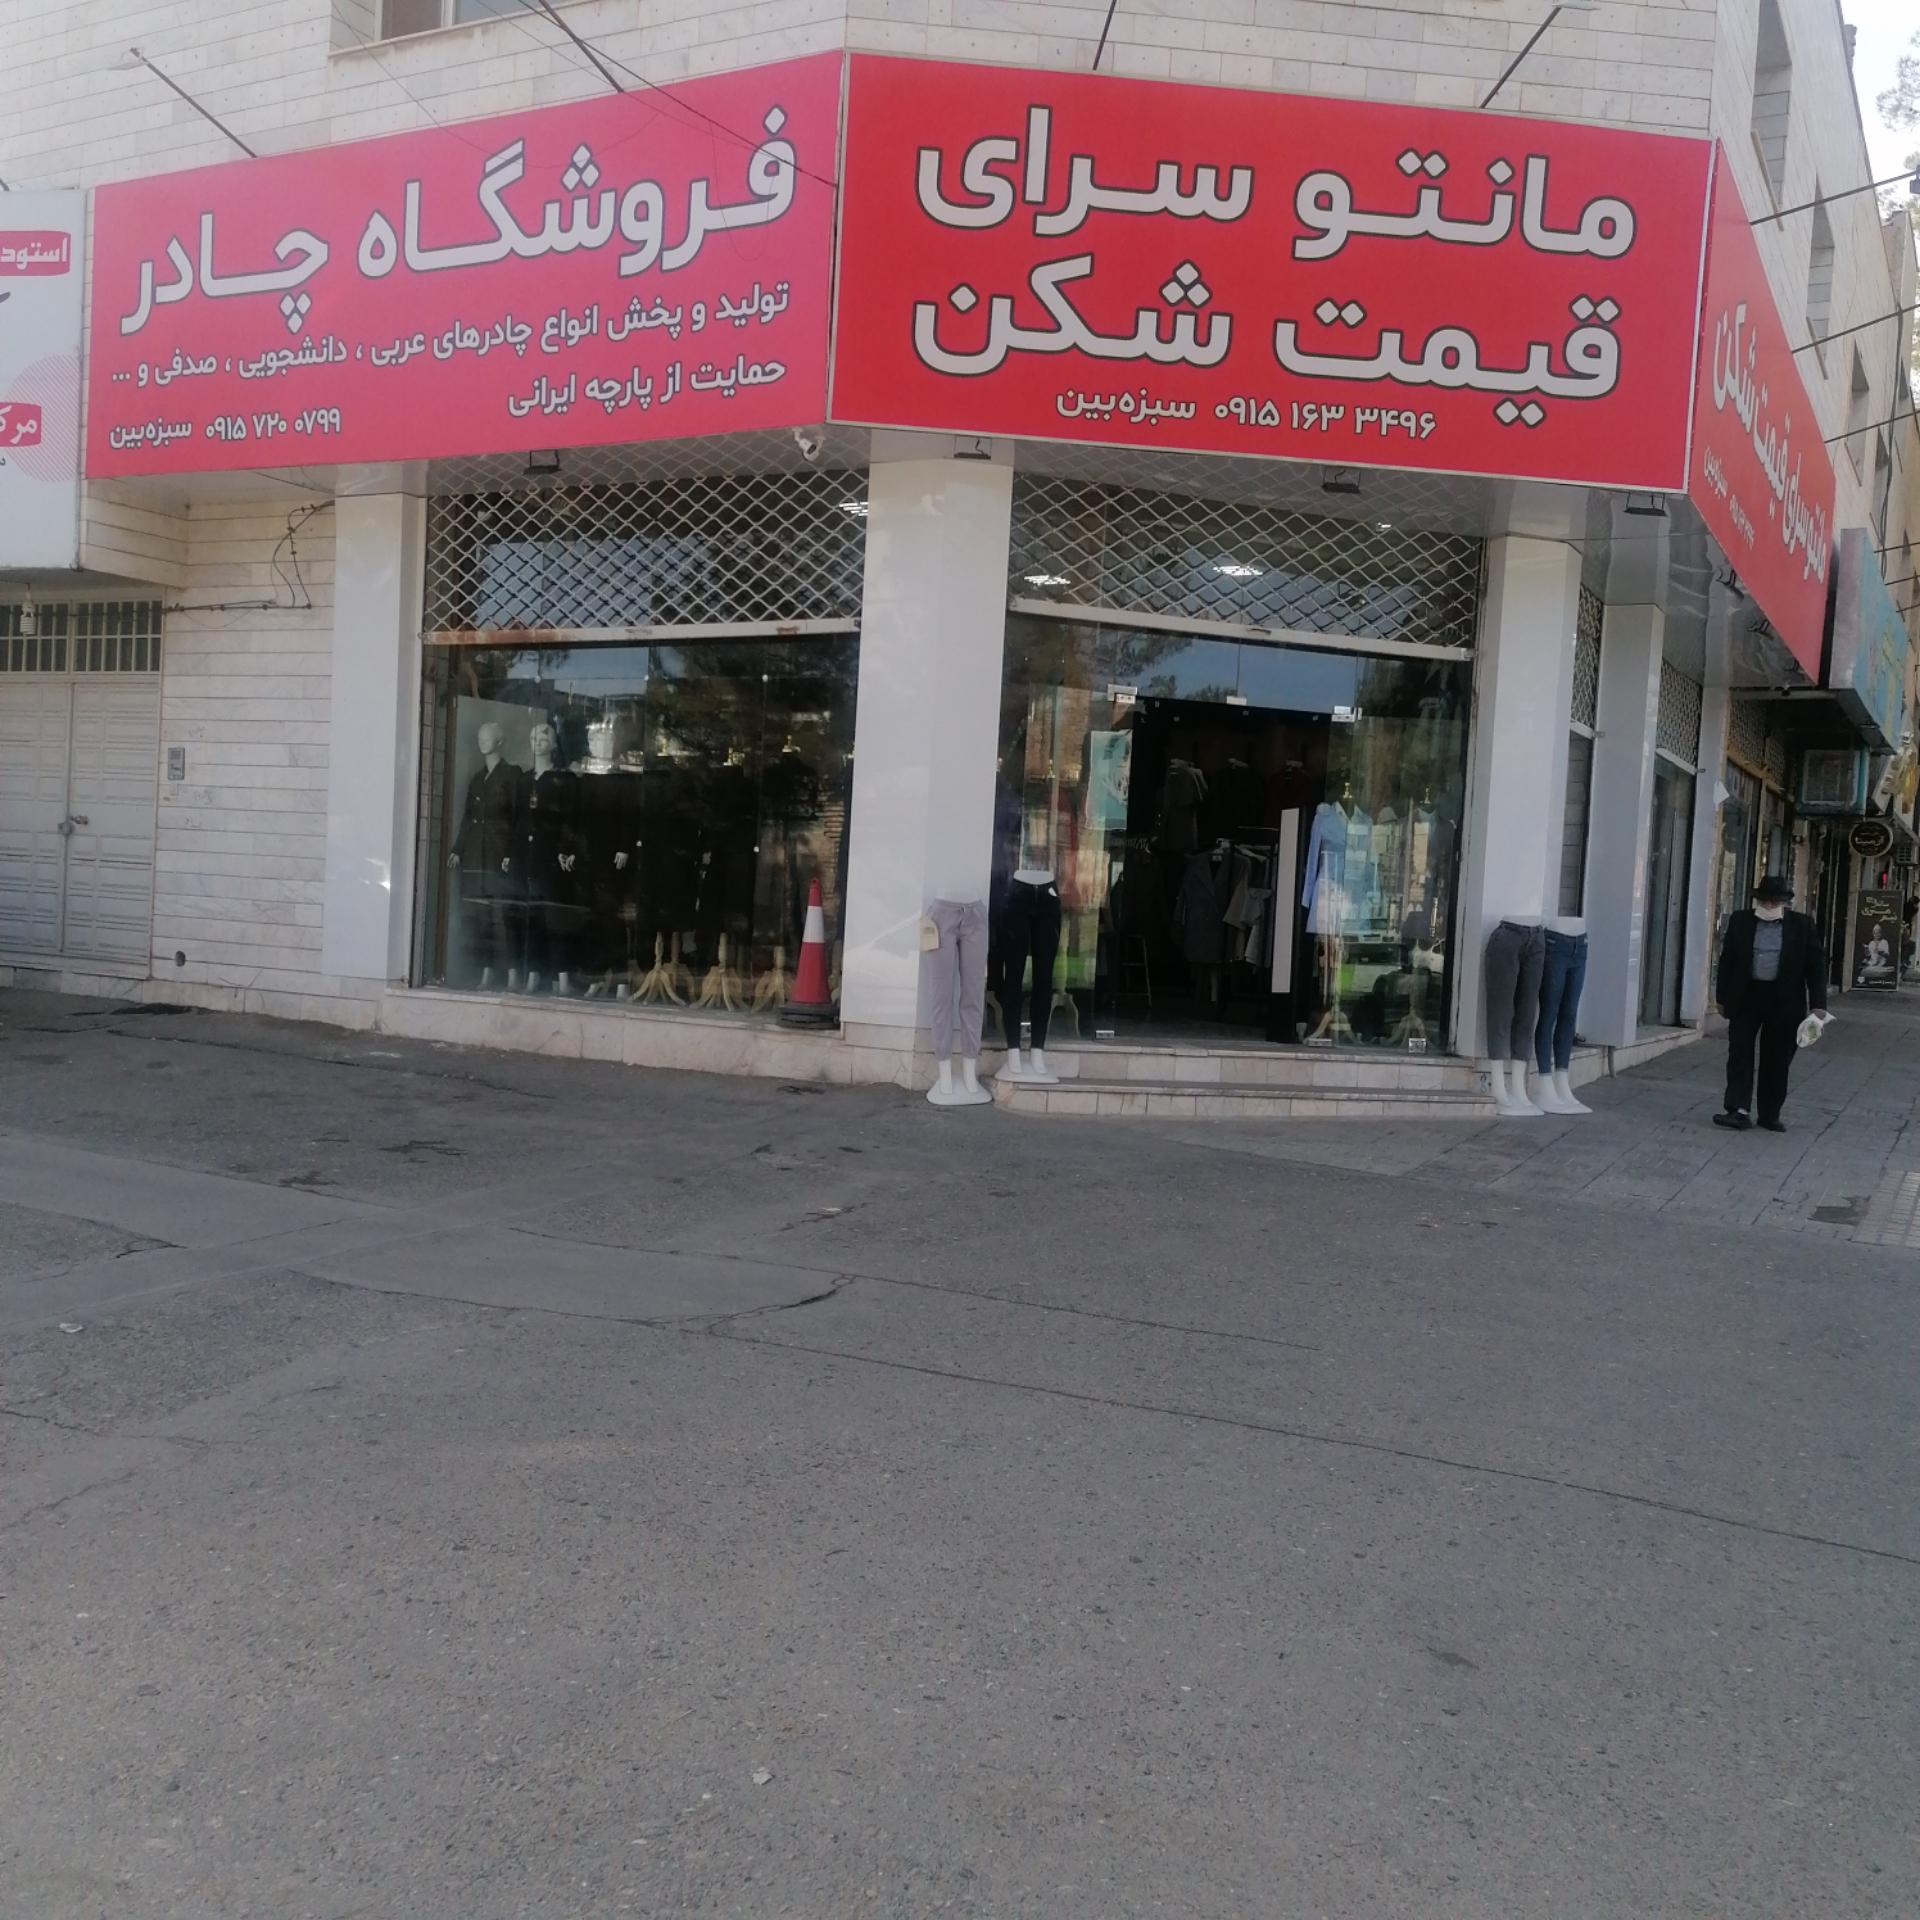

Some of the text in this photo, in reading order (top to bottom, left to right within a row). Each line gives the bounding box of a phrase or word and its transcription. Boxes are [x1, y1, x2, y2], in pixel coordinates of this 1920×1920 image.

[916, 104, 1637, 262] مانتو سرای
[120, 106, 797, 334] فروشگاه چادر
[0, 237, 67, 270] استود
[607, 297, 682, 339] پخش
[691, 301, 706, 331] و
[715, 281, 789, 324] تولید
[433, 315, 532, 360] چادرهای
[540, 304, 598, 353] انواع
[912, 252, 1621, 428] قیمت شکن
[137, 362, 148, 387] و
[154, 348, 216, 385] صدفی
[238, 335, 347, 379] دانشجویی
[1712, 303, 1756, 433] شکن
[508, 354, 786, 417] حمایت از پارچه ایرانی
[205, 415, 247, 441] ۰۹۱۵
[252, 411, 287, 439] ۷۲۰
[294, 407, 341, 434] ۰۷۹۹
[1214, 396, 1281, 427] ۰۹۱۵
[1290, 400, 1345, 432] ۱۶۳
[1354, 404, 1438, 440] ۳۴۹۶
[1753, 382, 1791, 520] قیمت
[1782, 452, 1811, 555] سرای
